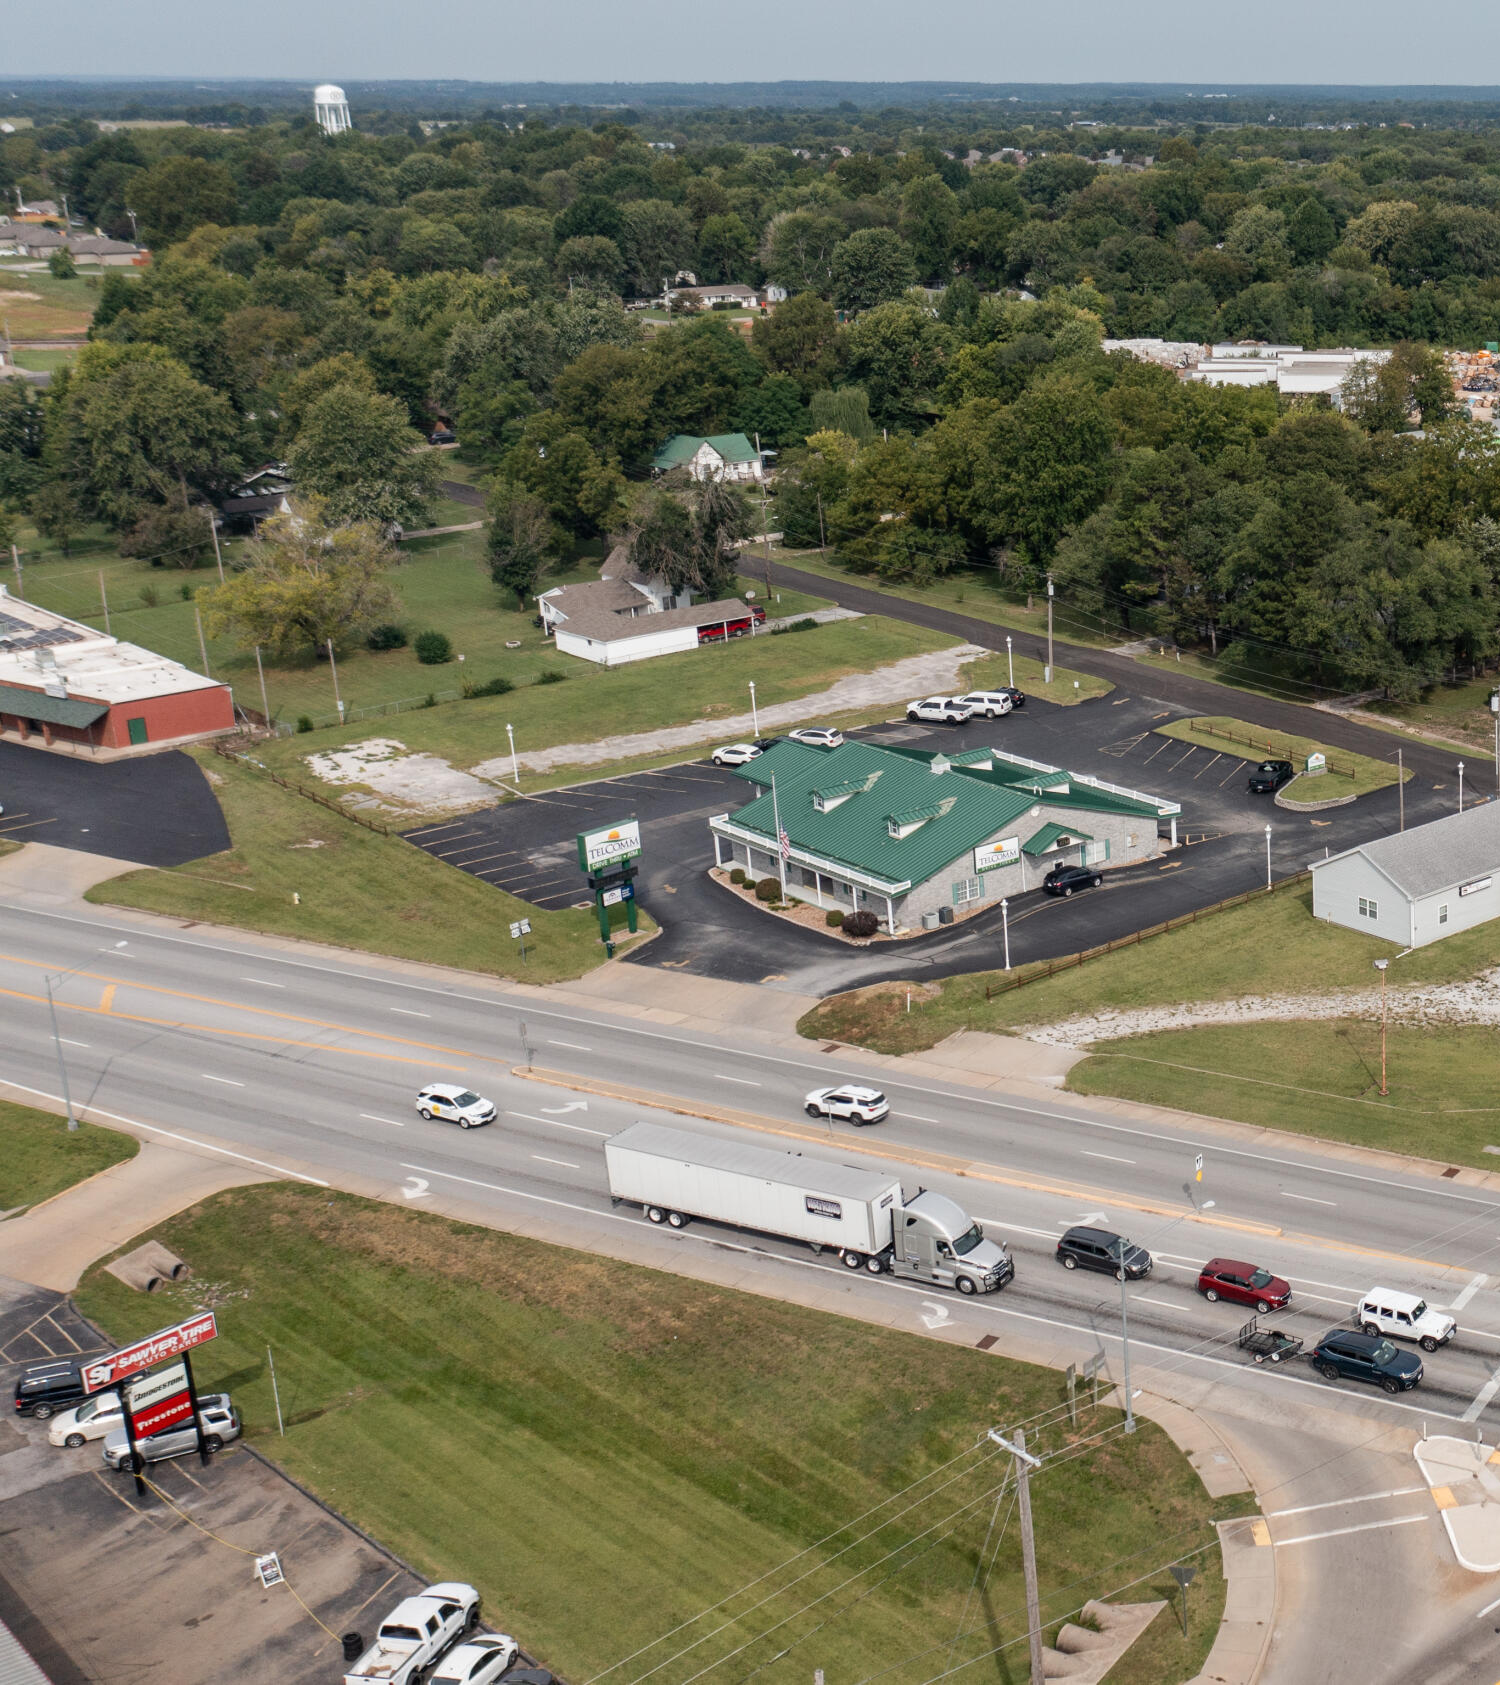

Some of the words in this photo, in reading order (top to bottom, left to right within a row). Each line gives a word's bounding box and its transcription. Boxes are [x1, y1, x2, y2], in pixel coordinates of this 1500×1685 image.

[592, 859, 608, 870] DRIVE
[118, 1336, 178, 1369] SAWYER
[180, 1320, 213, 1341] TIRE
[135, 1351, 167, 1367] AUTO
[171, 1336, 198, 1353] CARE
[134, 1374, 185, 1402] BRIDGESTONE
[136, 1401, 191, 1431] Firestone
